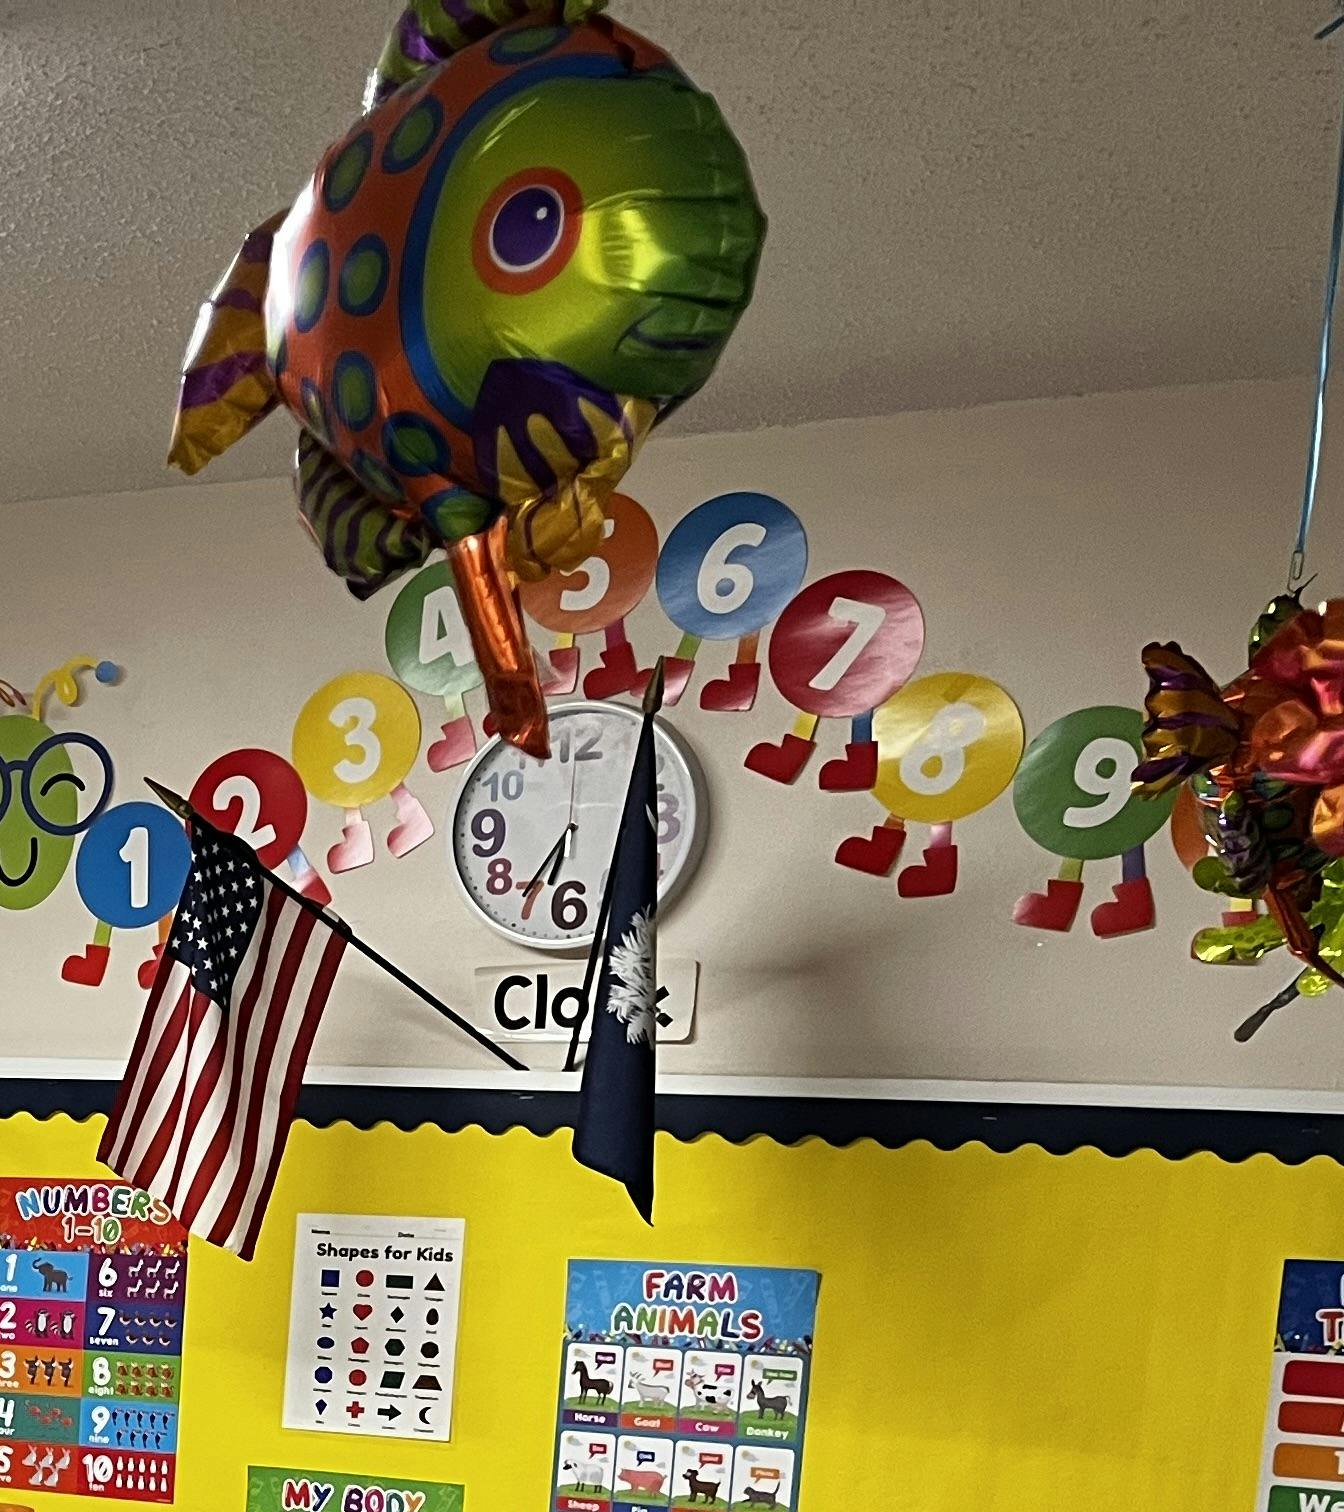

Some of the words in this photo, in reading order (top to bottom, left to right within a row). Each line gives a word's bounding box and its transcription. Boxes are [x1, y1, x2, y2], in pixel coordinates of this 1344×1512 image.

[697, 523, 767, 614] 6
[420, 586, 474, 666] 4
[809, 597, 885, 691] 7
[328, 697, 380, 784] 3
[551, 720, 603, 763] 12
[899, 703, 985, 796] 8
[482, 769, 523, 801] 10
[1063, 738, 1140, 828] 9
[212, 776, 276, 852] 2
[471, 809, 506, 857] 9
[119, 827, 148, 908] 1
[486, 858, 512, 895] 8
[516, 880, 544, 920] 7
[551, 880, 587, 930] 6
[494, 973, 673, 1030] Clo
[17, 1185, 172, 1224] NUMBERS
[62, 1216, 121, 1244] 1-10
[5, 1253, 17, 1282] 1
[317, 1243, 378, 1261] Shapes
[385, 1245, 412, 1260] for
[417, 1247, 453, 1262] Kids
[98, 1258, 118, 1287] 6
[645, 1271, 736, 1302] FARM
[0, 1302, 16, 1330] 2
[97, 1308, 115, 1336] 7
[614, 1303, 762, 1340] ANIMALS
[92, 1357, 111, 1386] 8
[91, 1406, 109, 1433] 9
[695, 1423, 719, 1433] Cow
[747, 1427, 789, 1439] Donkey
[82, 1454, 113, 1482] 10
[285, 1480, 332, 1512] MY
